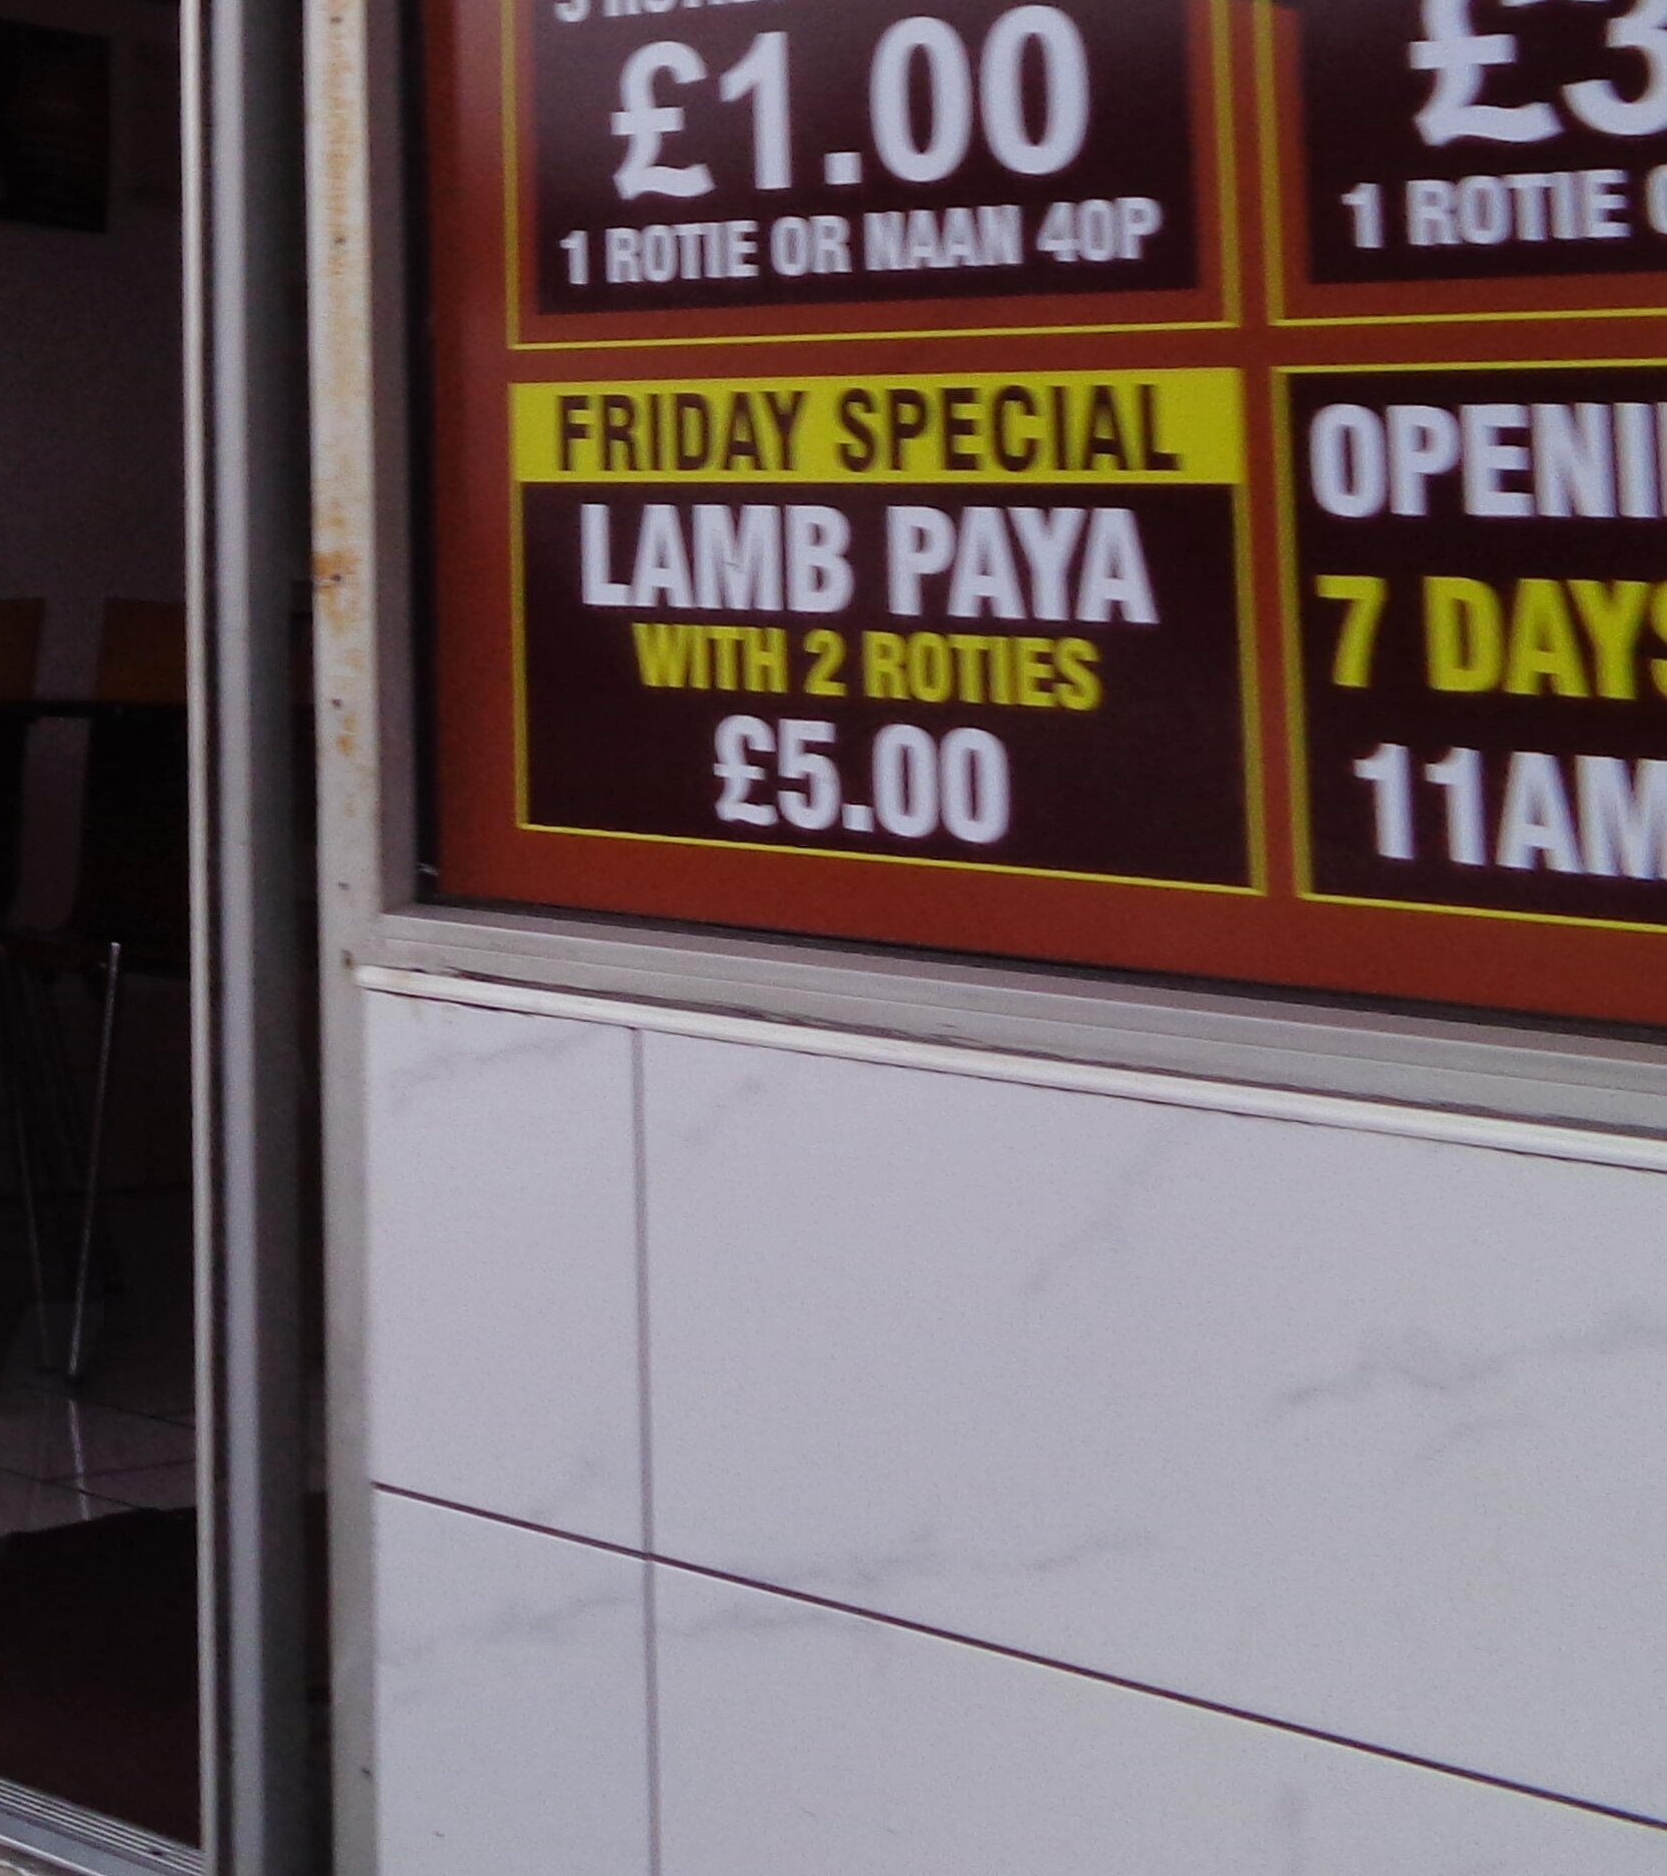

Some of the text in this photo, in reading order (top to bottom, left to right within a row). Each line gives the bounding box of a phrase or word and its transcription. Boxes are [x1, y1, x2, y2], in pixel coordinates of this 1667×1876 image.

[611, 1, 1089, 202] £1.00
[561, 195, 1163, 286] 1 ROTIE OR NAAN 40P
[1343, 182, 1381, 249] 1
[1407, 169, 1629, 246] ROTIE
[558, 384, 1181, 474] FRIDAY SPECIAL
[1310, 401, 1667, 518] OPENI
[580, 502, 1158, 624] LAMB PAYA
[632, 623, 1100, 711] WITH 2 ROTIES
[1314, 574, 1386, 688] 7
[714, 713, 1010, 843] £5.00
